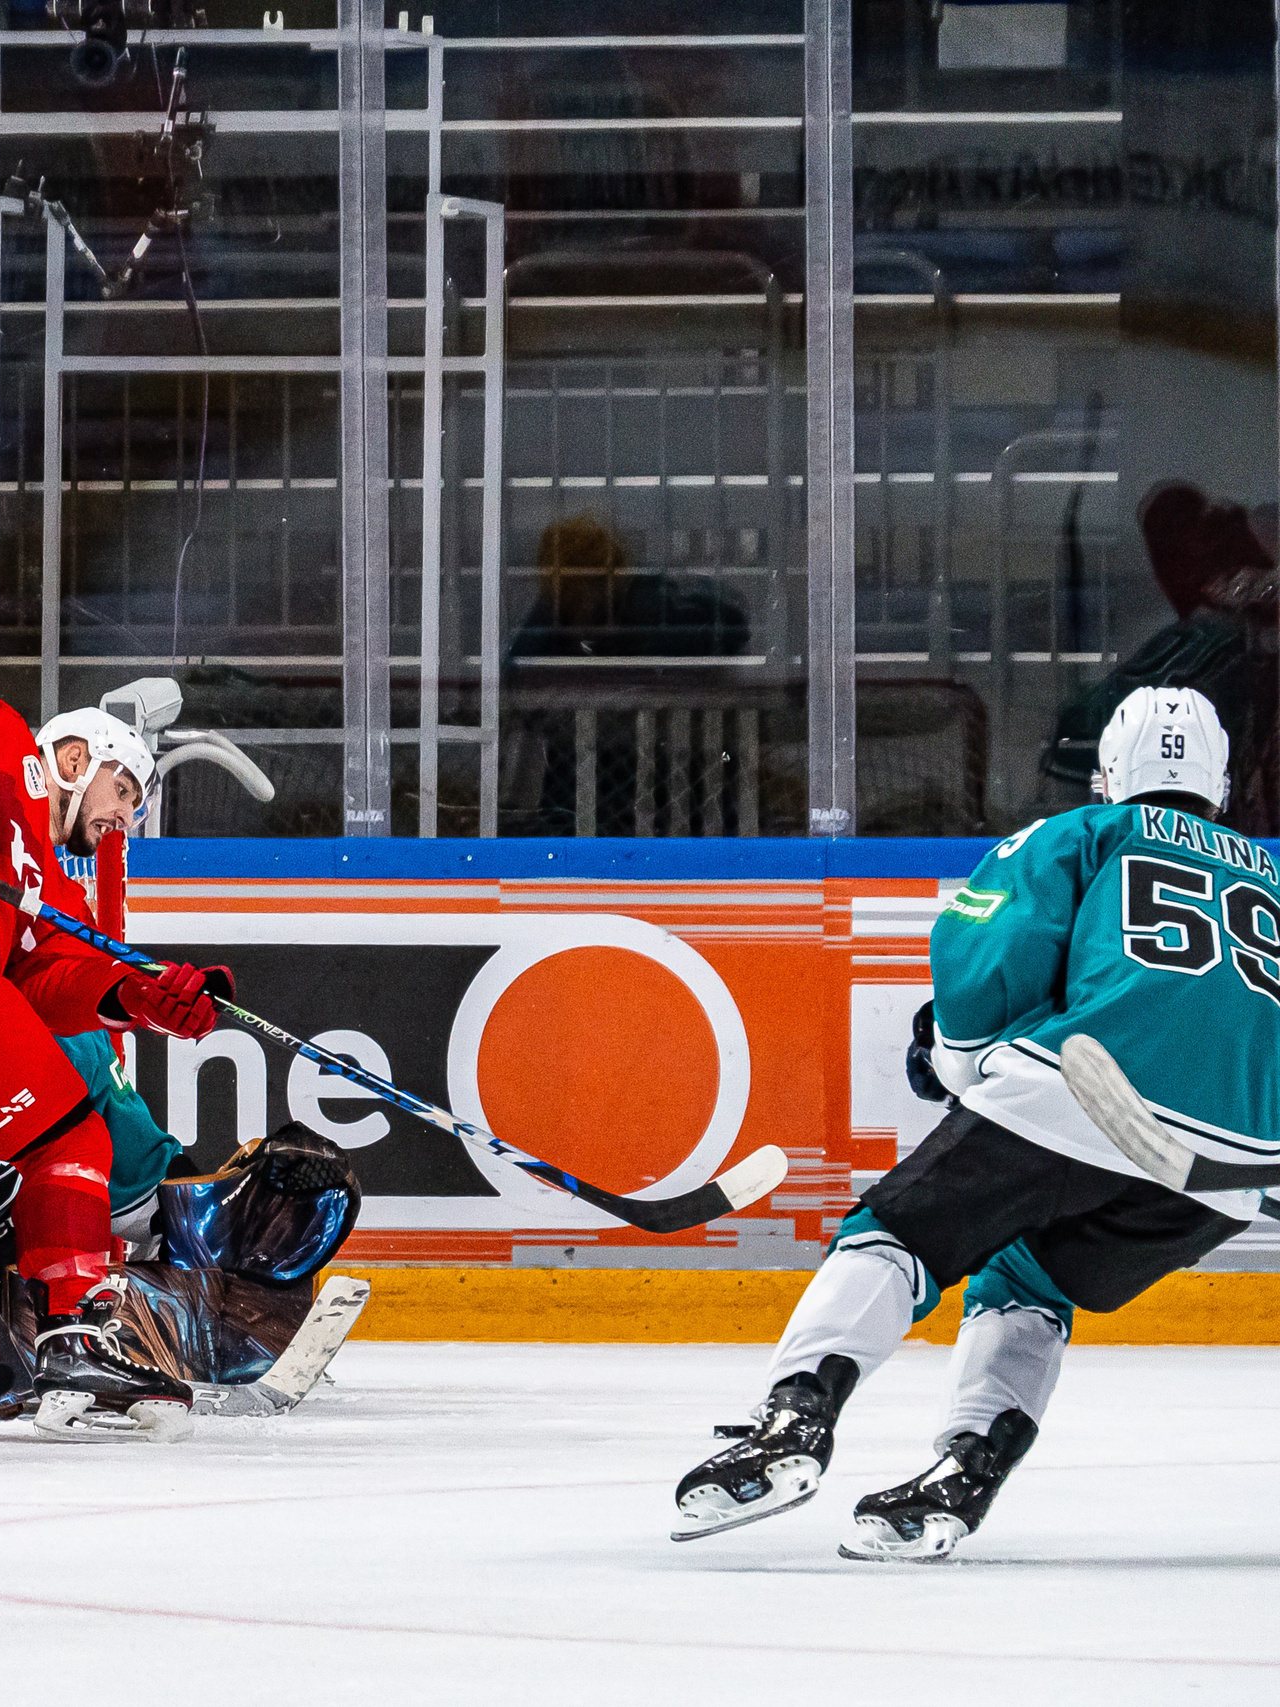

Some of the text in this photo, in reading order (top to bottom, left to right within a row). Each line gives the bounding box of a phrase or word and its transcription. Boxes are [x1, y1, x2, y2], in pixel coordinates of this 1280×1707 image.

[1159, 733, 1186, 760] 59
[1139, 803, 1279, 887] KALINA
[1121, 854, 1280, 1011] 59
